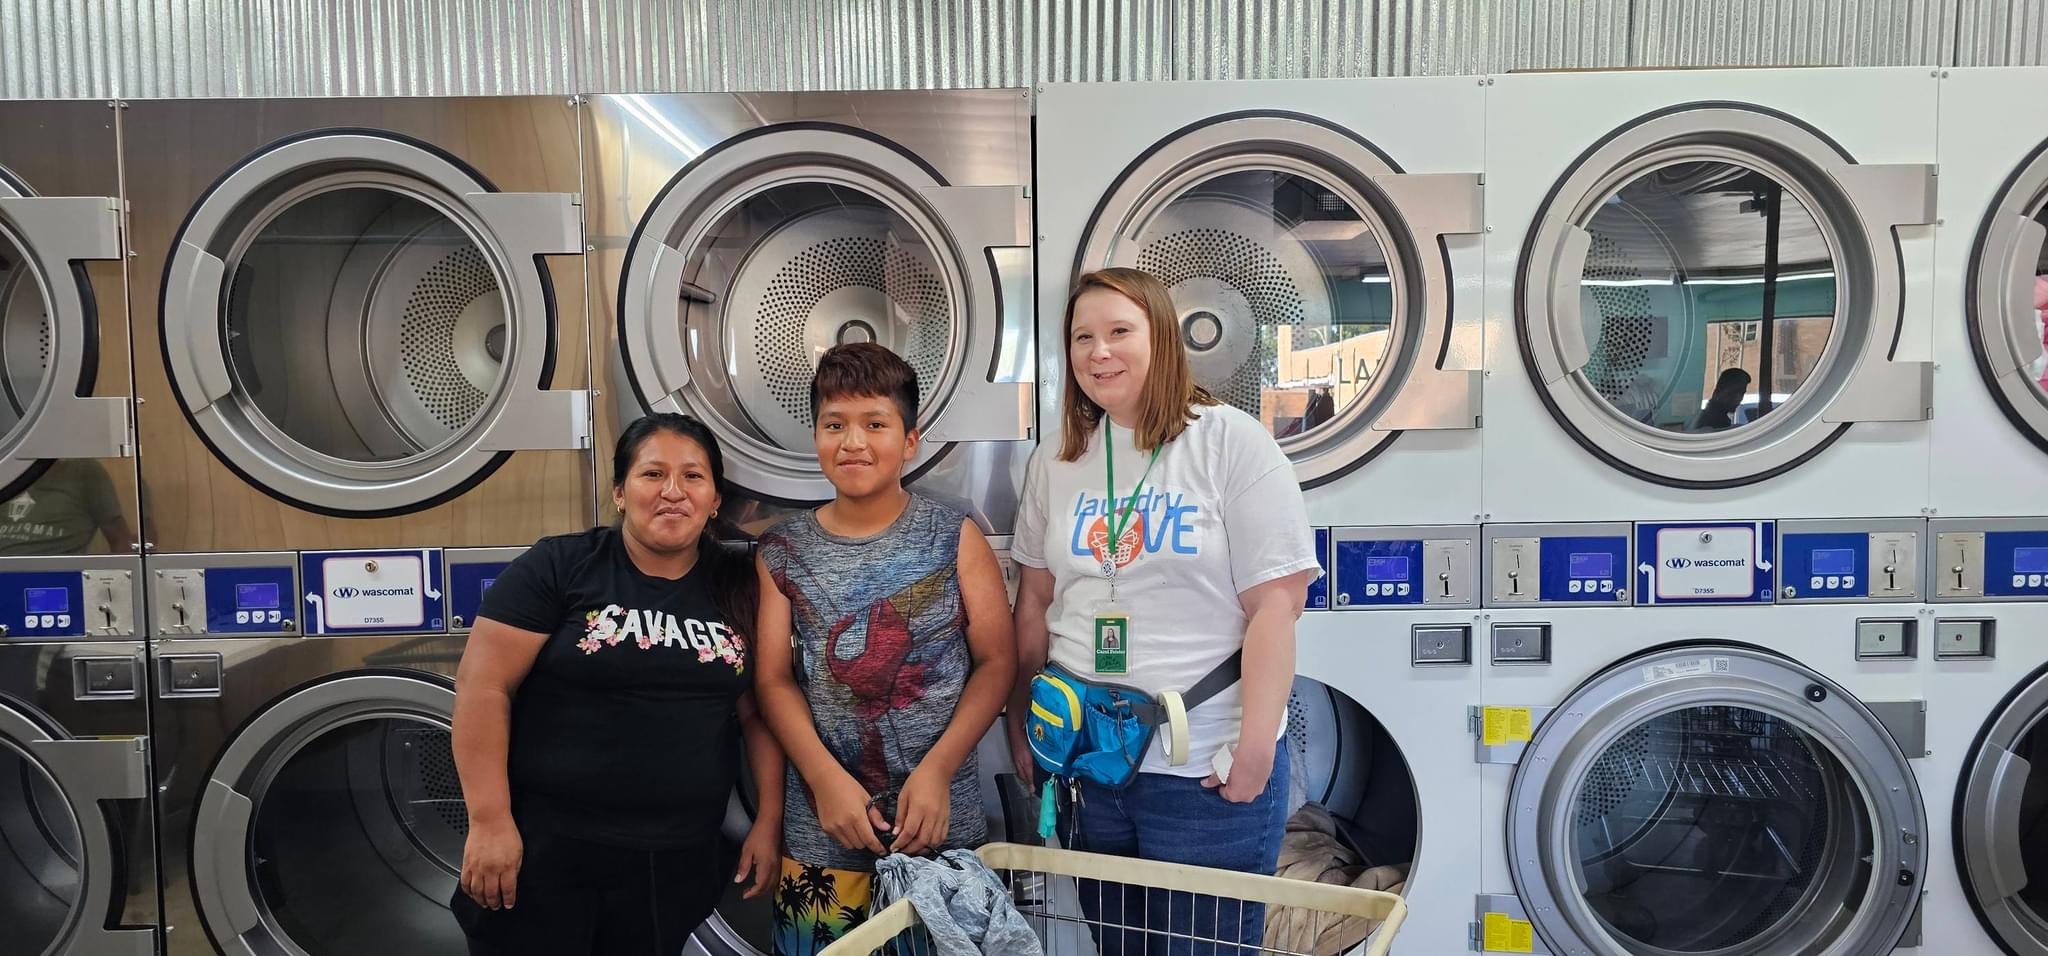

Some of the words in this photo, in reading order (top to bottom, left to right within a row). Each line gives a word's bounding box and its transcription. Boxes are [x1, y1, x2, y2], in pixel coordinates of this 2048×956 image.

[1339, 358, 1381, 384] LA
[1694, 557, 1745, 567] wascomat
[362, 586, 414, 597] wascomat
[588, 604, 738, 662] SAVAGE
